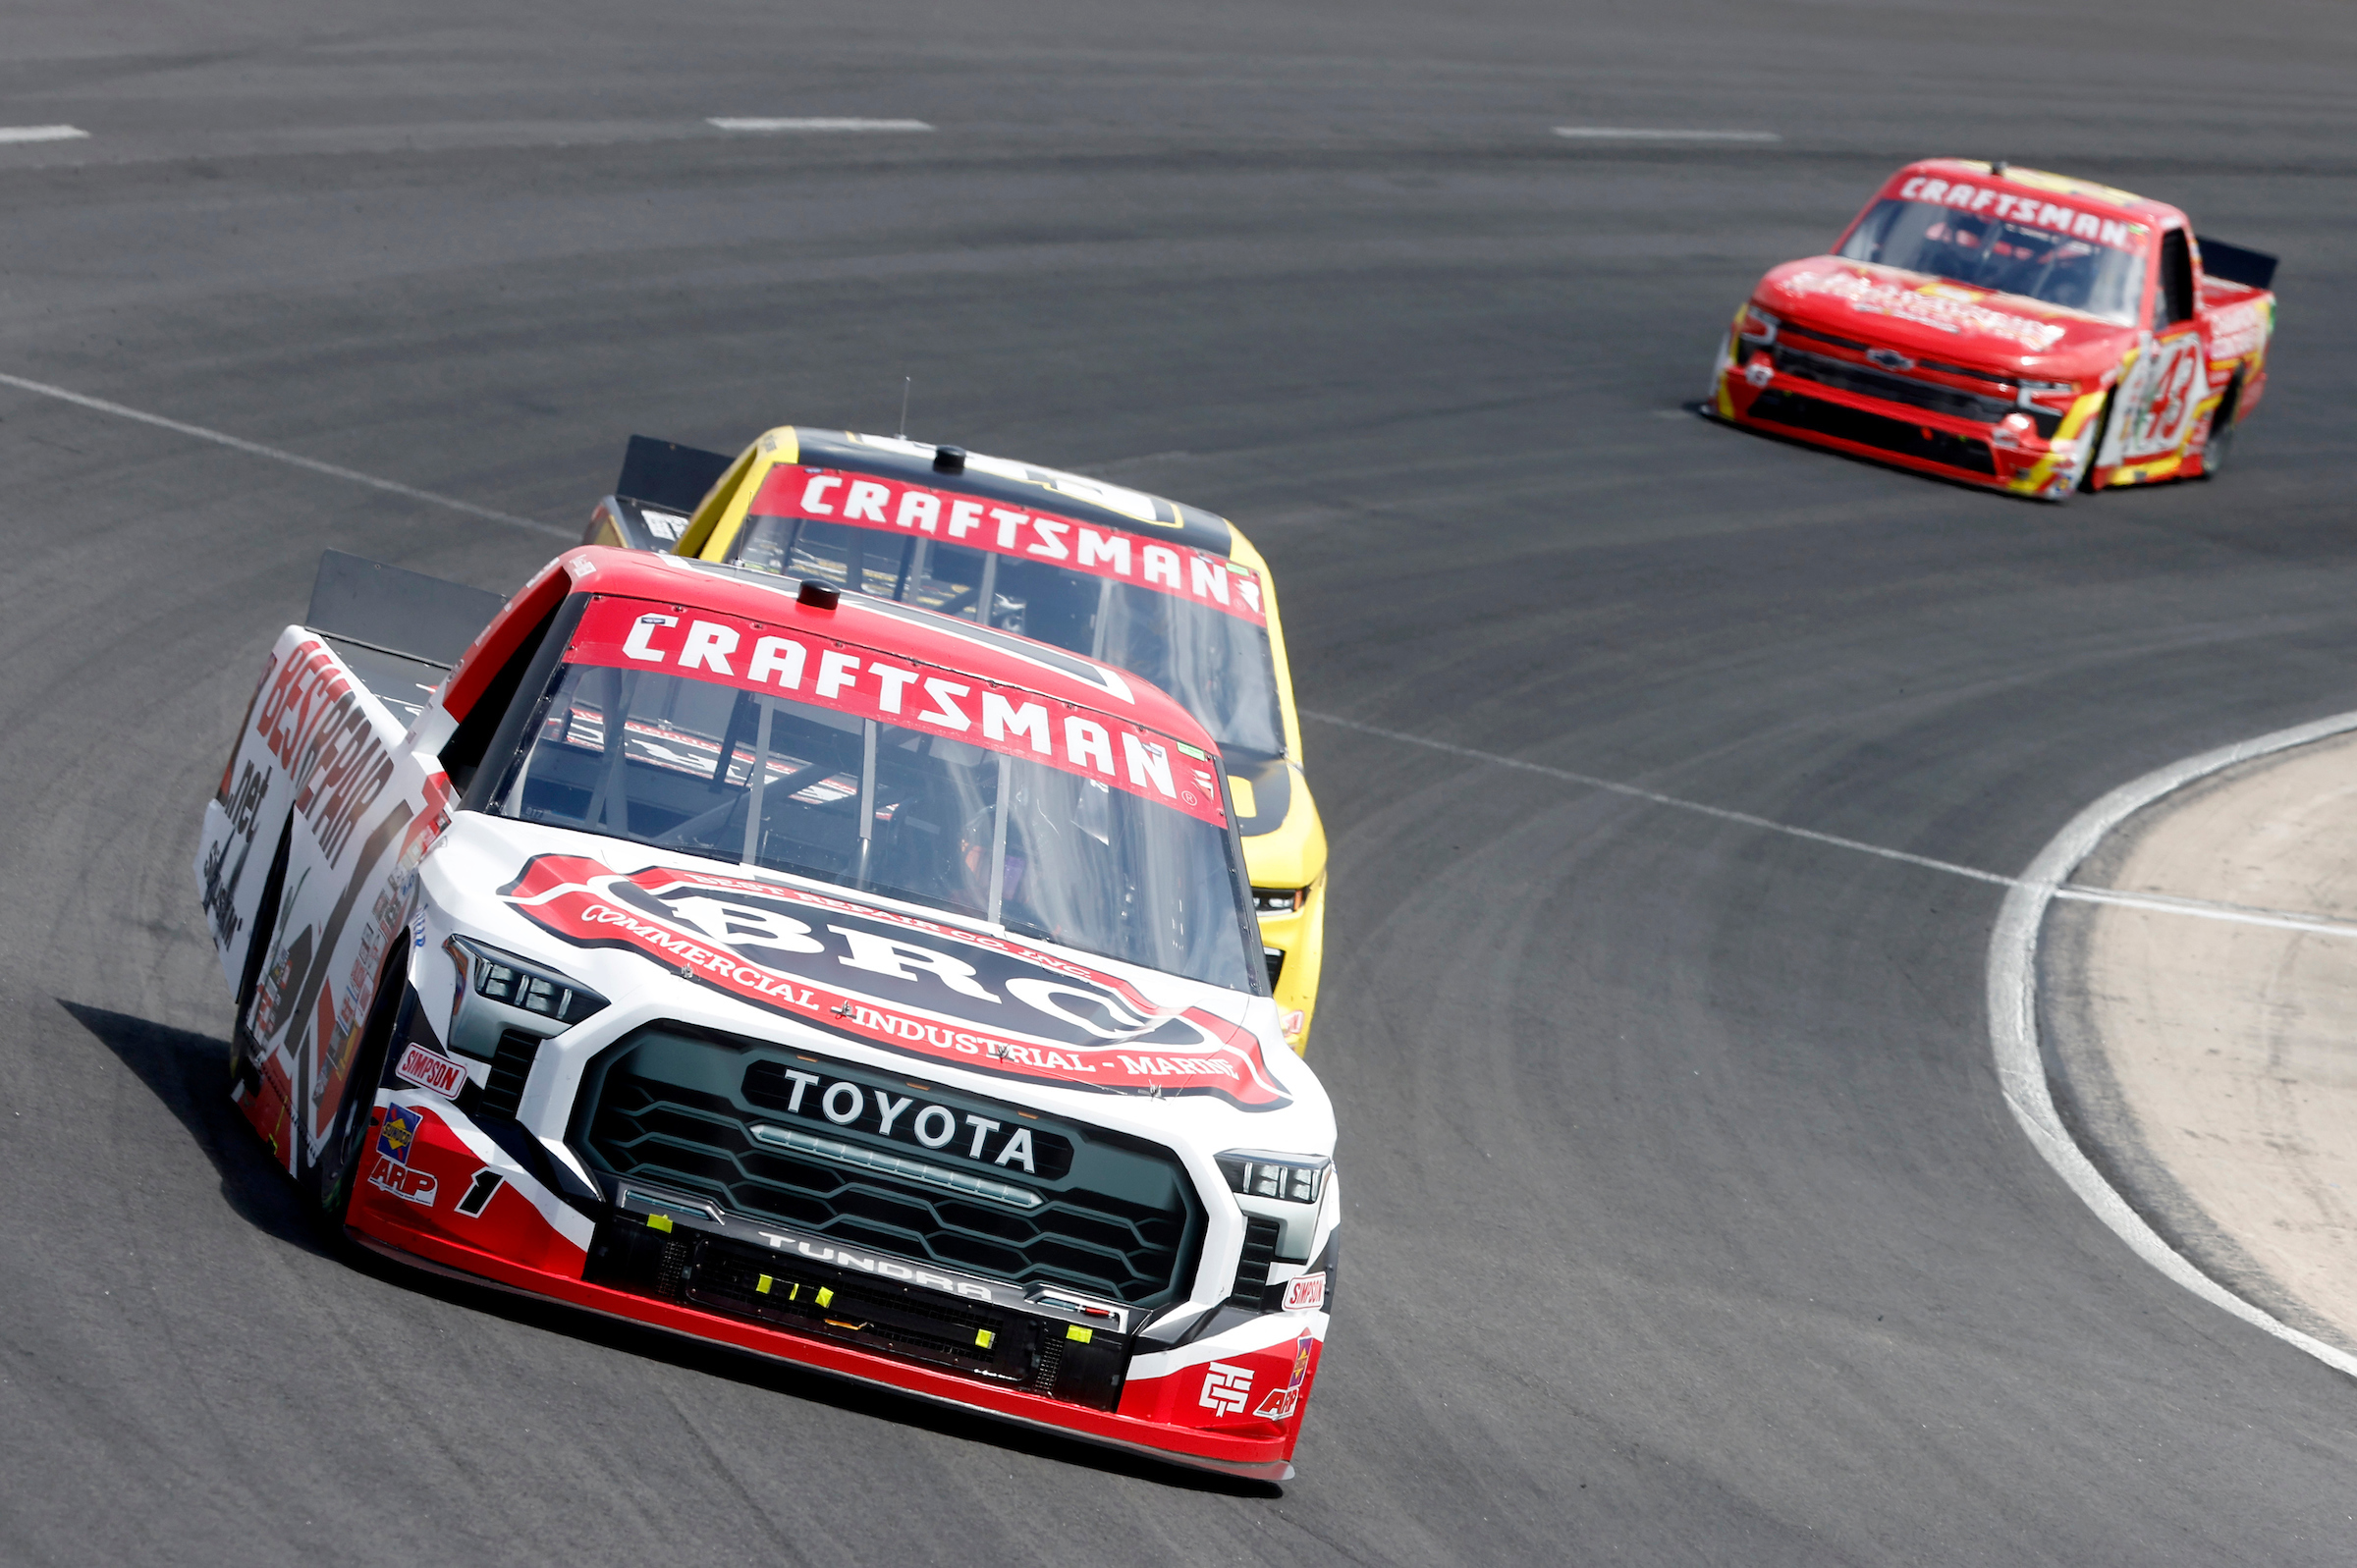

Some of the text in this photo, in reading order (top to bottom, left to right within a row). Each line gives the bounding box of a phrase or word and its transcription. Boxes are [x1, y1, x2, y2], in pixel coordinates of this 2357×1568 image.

[1900, 177, 2128, 246] CRAFTSMAN
[800, 475, 1231, 606] CRAFTSMAN
[623, 613, 1178, 799] CRAFTSMAN
[684, 873, 786, 895] BEST
[794, 891, 941, 933] REPAIR
[580, 904, 820, 1010] COMMERCIAL
[851, 1005, 1097, 1072] INDUSTRIAL
[1117, 1054, 1240, 1080] MARINE
[671, 894, 1156, 1034] BRC
[402, 1050, 460, 1092] SIMPSON
[785, 1068, 1035, 1174] TOYOTA
[369, 1158, 436, 1197] ARP
[457, 1167, 505, 1217] 1
[758, 1230, 992, 1300] TUNDRA
